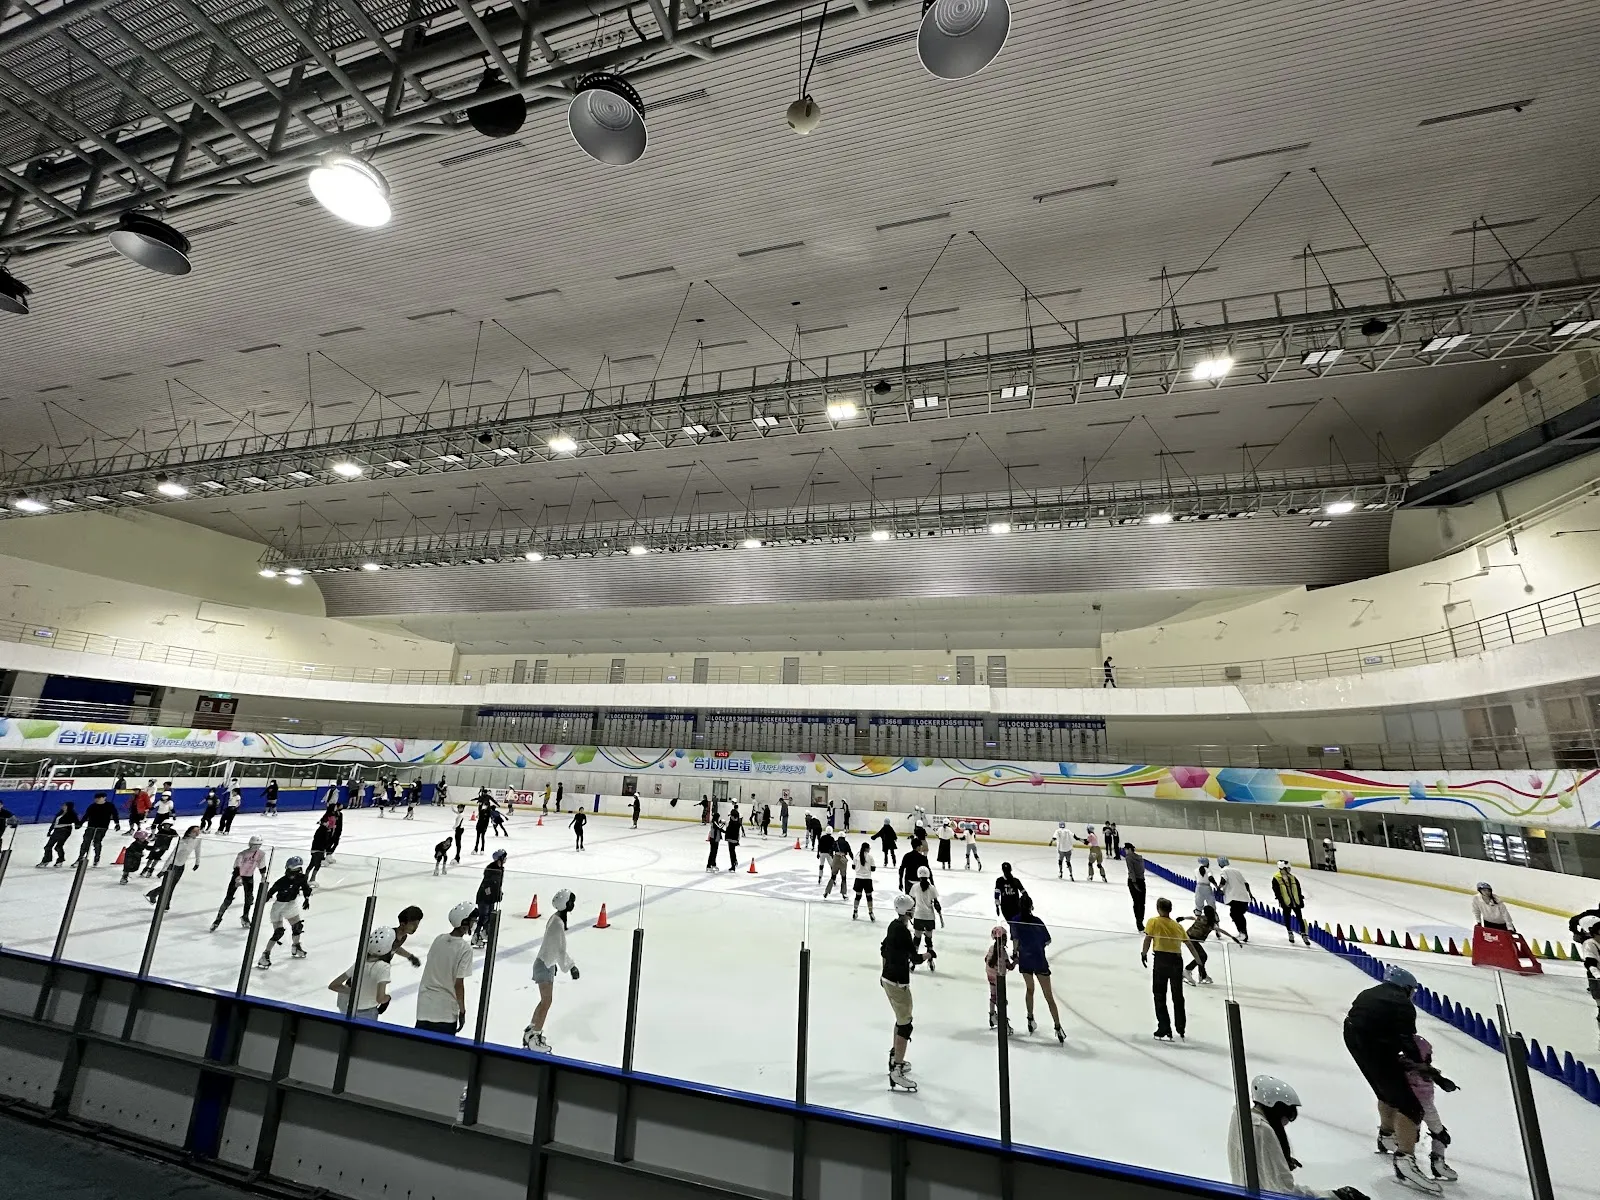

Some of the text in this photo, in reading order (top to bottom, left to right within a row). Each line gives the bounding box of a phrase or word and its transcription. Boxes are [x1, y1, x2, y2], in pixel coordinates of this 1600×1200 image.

[58, 730, 148, 747] 台北小巨蛋
[153, 737, 216, 749] TAIPEI ARENA
[694, 757, 751, 772] 台北小巨蛋
[756, 762, 807, 774] TAIPEI ARENA
